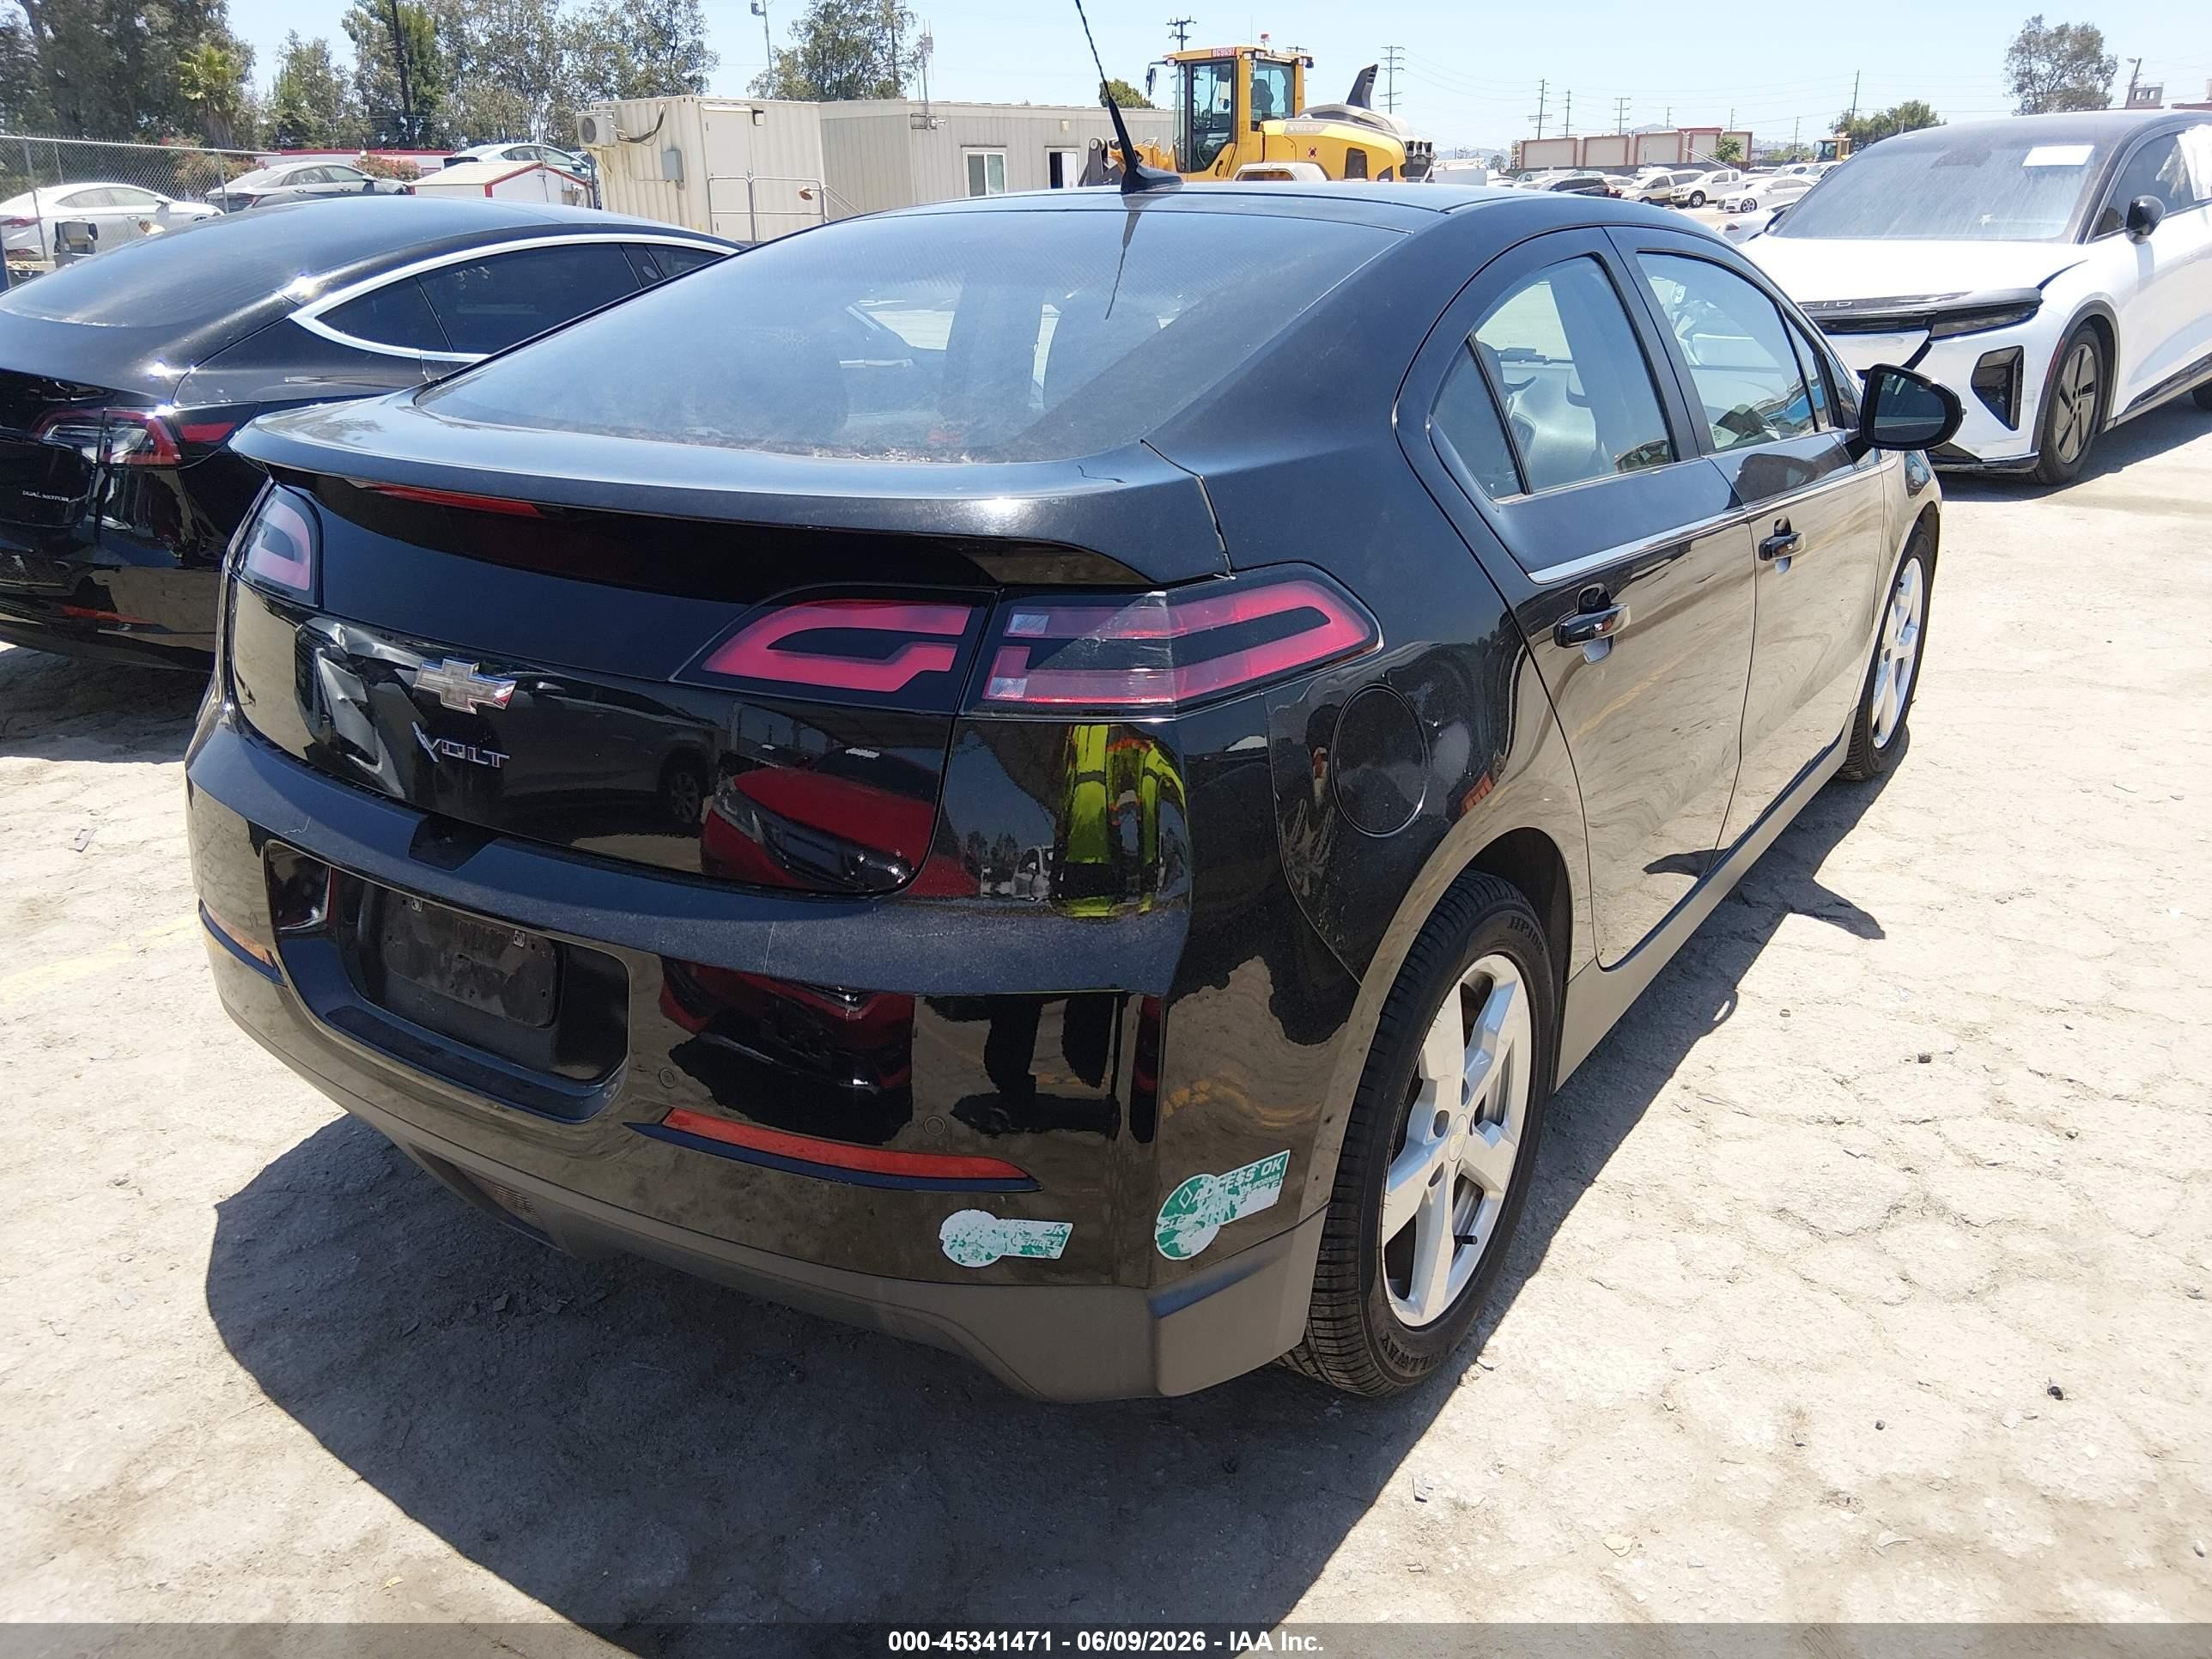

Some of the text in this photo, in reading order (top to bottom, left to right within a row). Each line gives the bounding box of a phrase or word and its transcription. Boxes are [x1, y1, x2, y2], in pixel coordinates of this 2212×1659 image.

[42, 494, 69, 502] MOTOR
[411, 720, 510, 768] VOLT
[1260, 1156, 1285, 1176] OK
